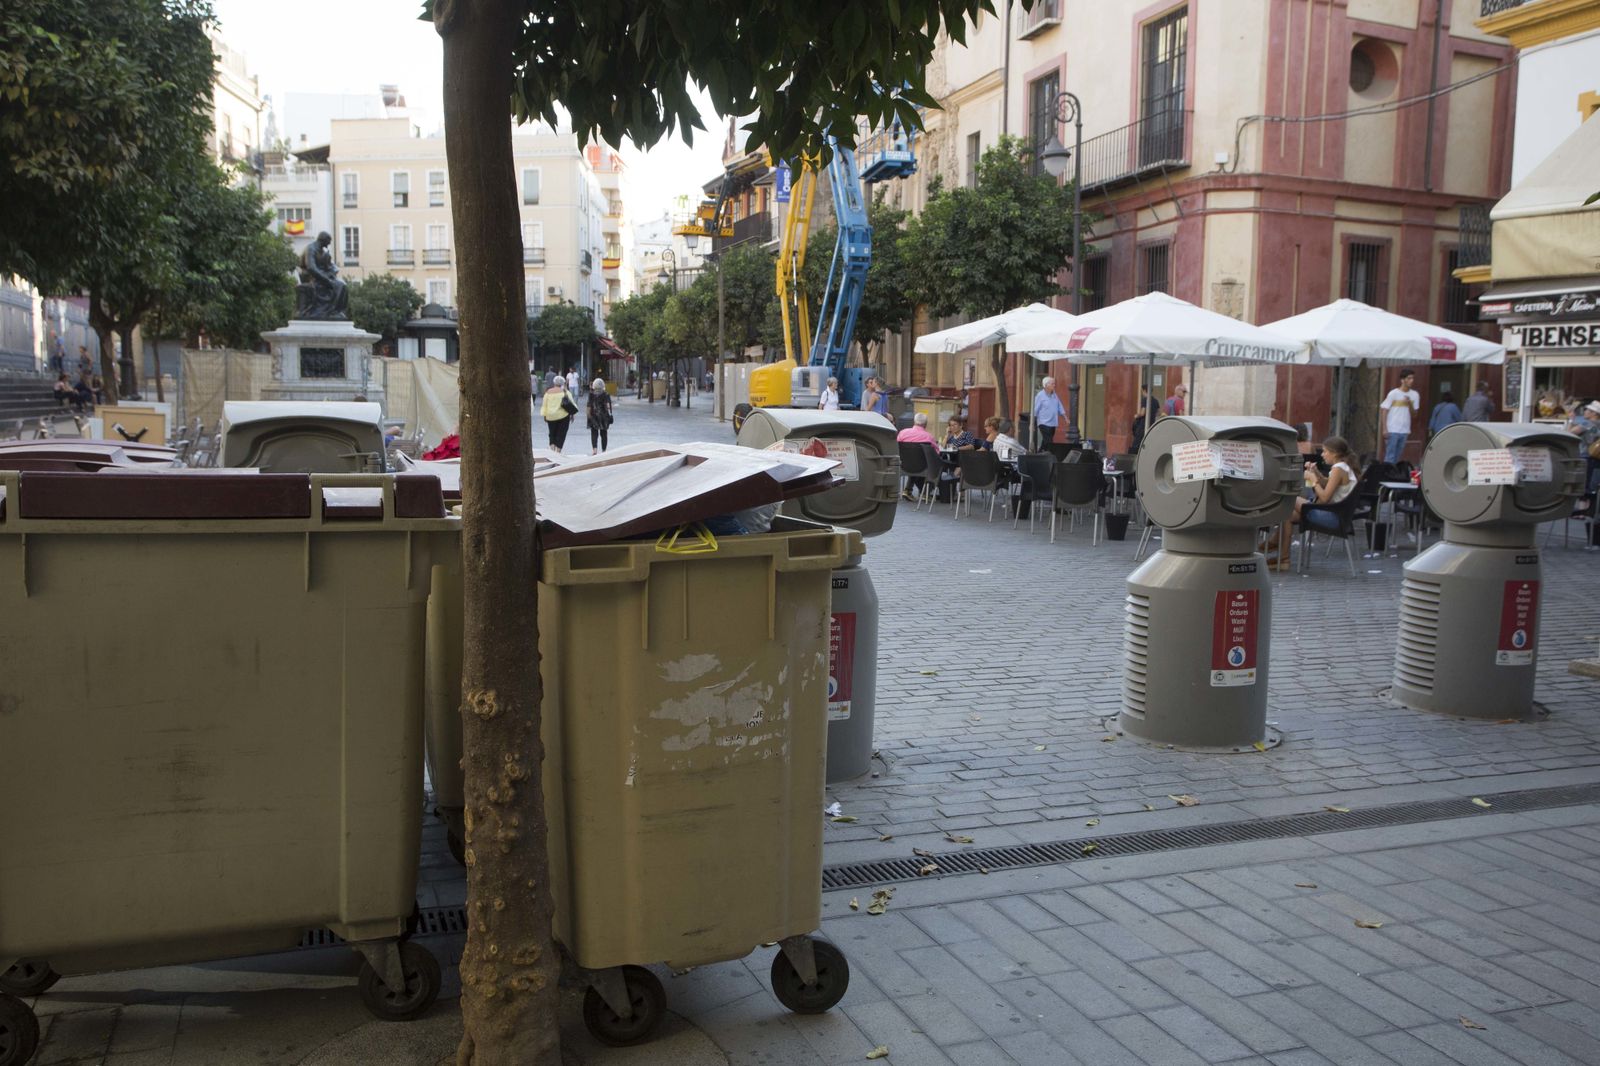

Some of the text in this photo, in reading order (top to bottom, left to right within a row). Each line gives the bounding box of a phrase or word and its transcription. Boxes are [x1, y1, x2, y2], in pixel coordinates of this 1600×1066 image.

[1514, 302, 1554, 313] CAFETERIA
[1521, 325, 1600, 347] IBENSE
[1231, 600, 1248, 608] Basura
